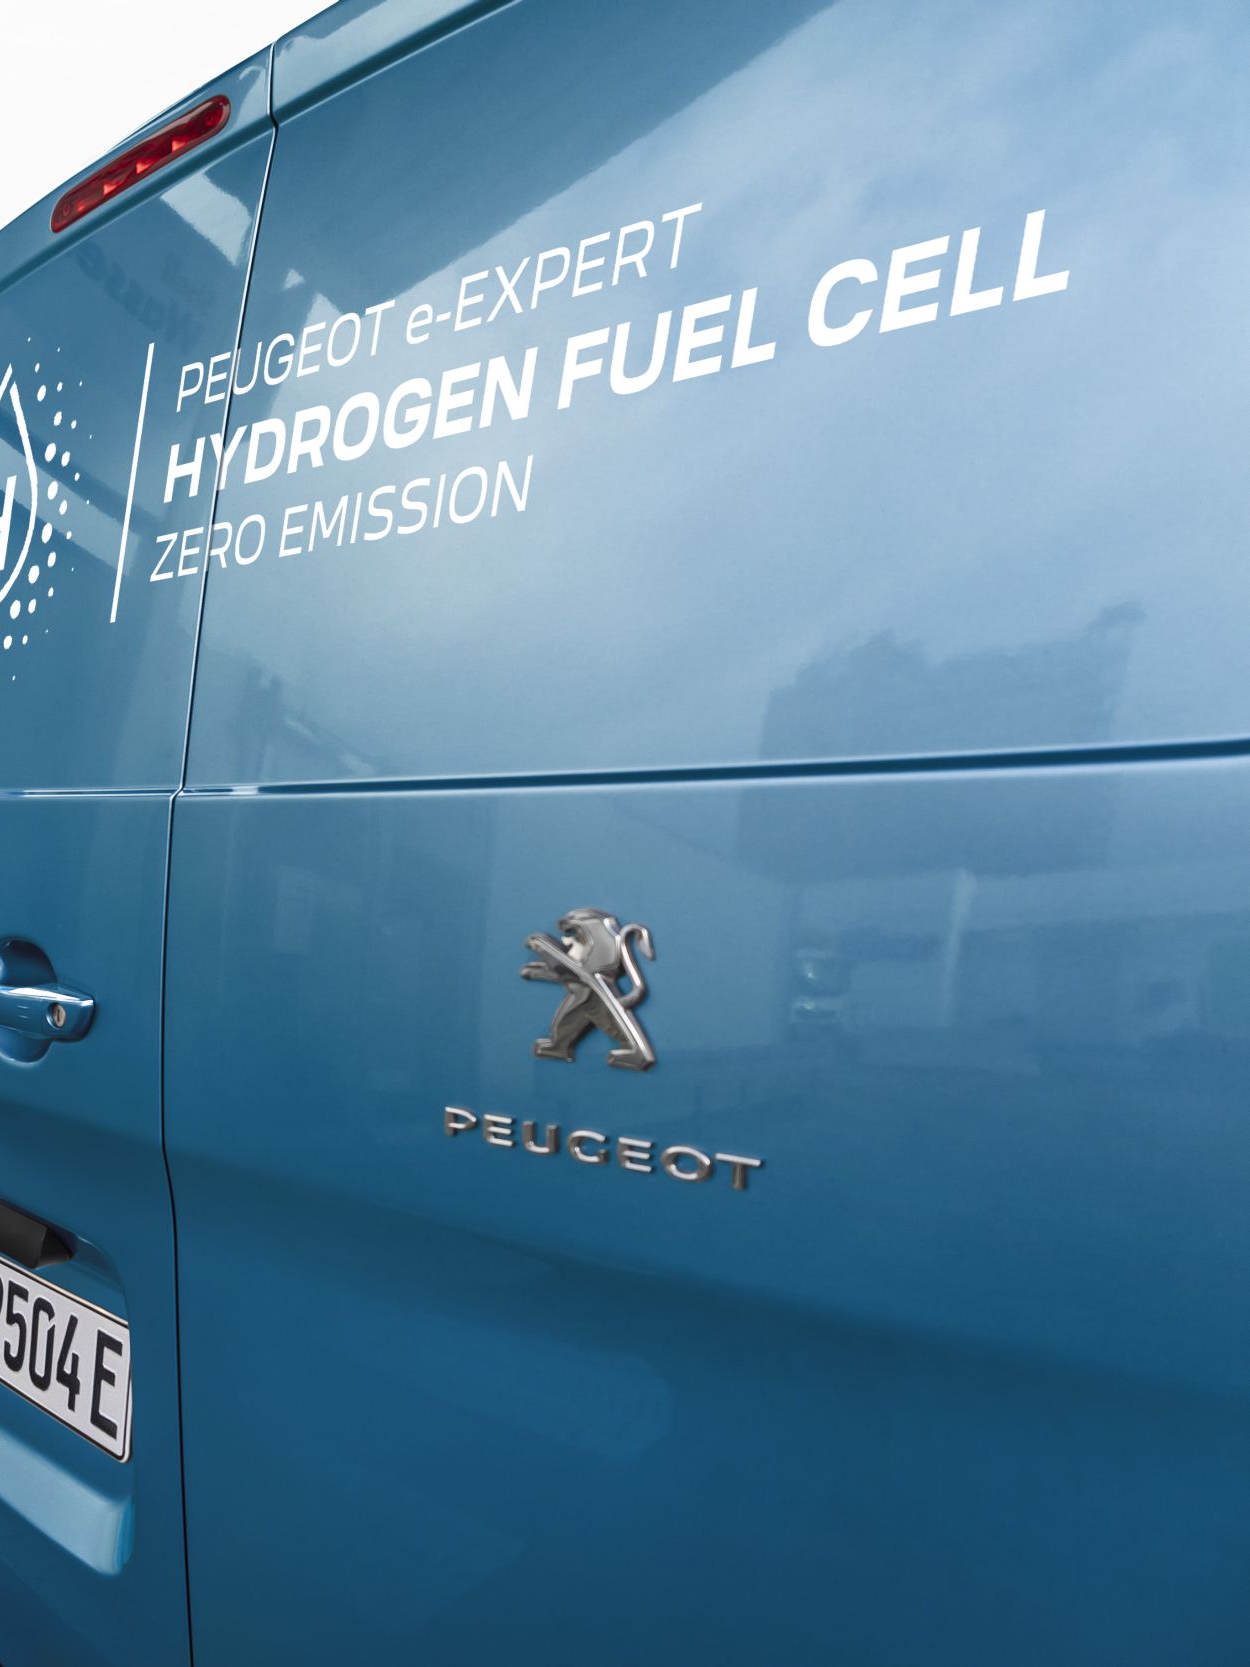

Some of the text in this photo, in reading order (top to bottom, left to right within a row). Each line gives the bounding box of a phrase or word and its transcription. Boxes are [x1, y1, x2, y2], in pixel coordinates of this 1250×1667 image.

[163, 208, 1070, 503] HYDROGEN FUEL CELL
[176, 201, 703, 412] PEUGEOT e-EXPERT
[150, 454, 534, 582] ZERO EMISSION
[444, 1106, 763, 1190] PEUGEOT
